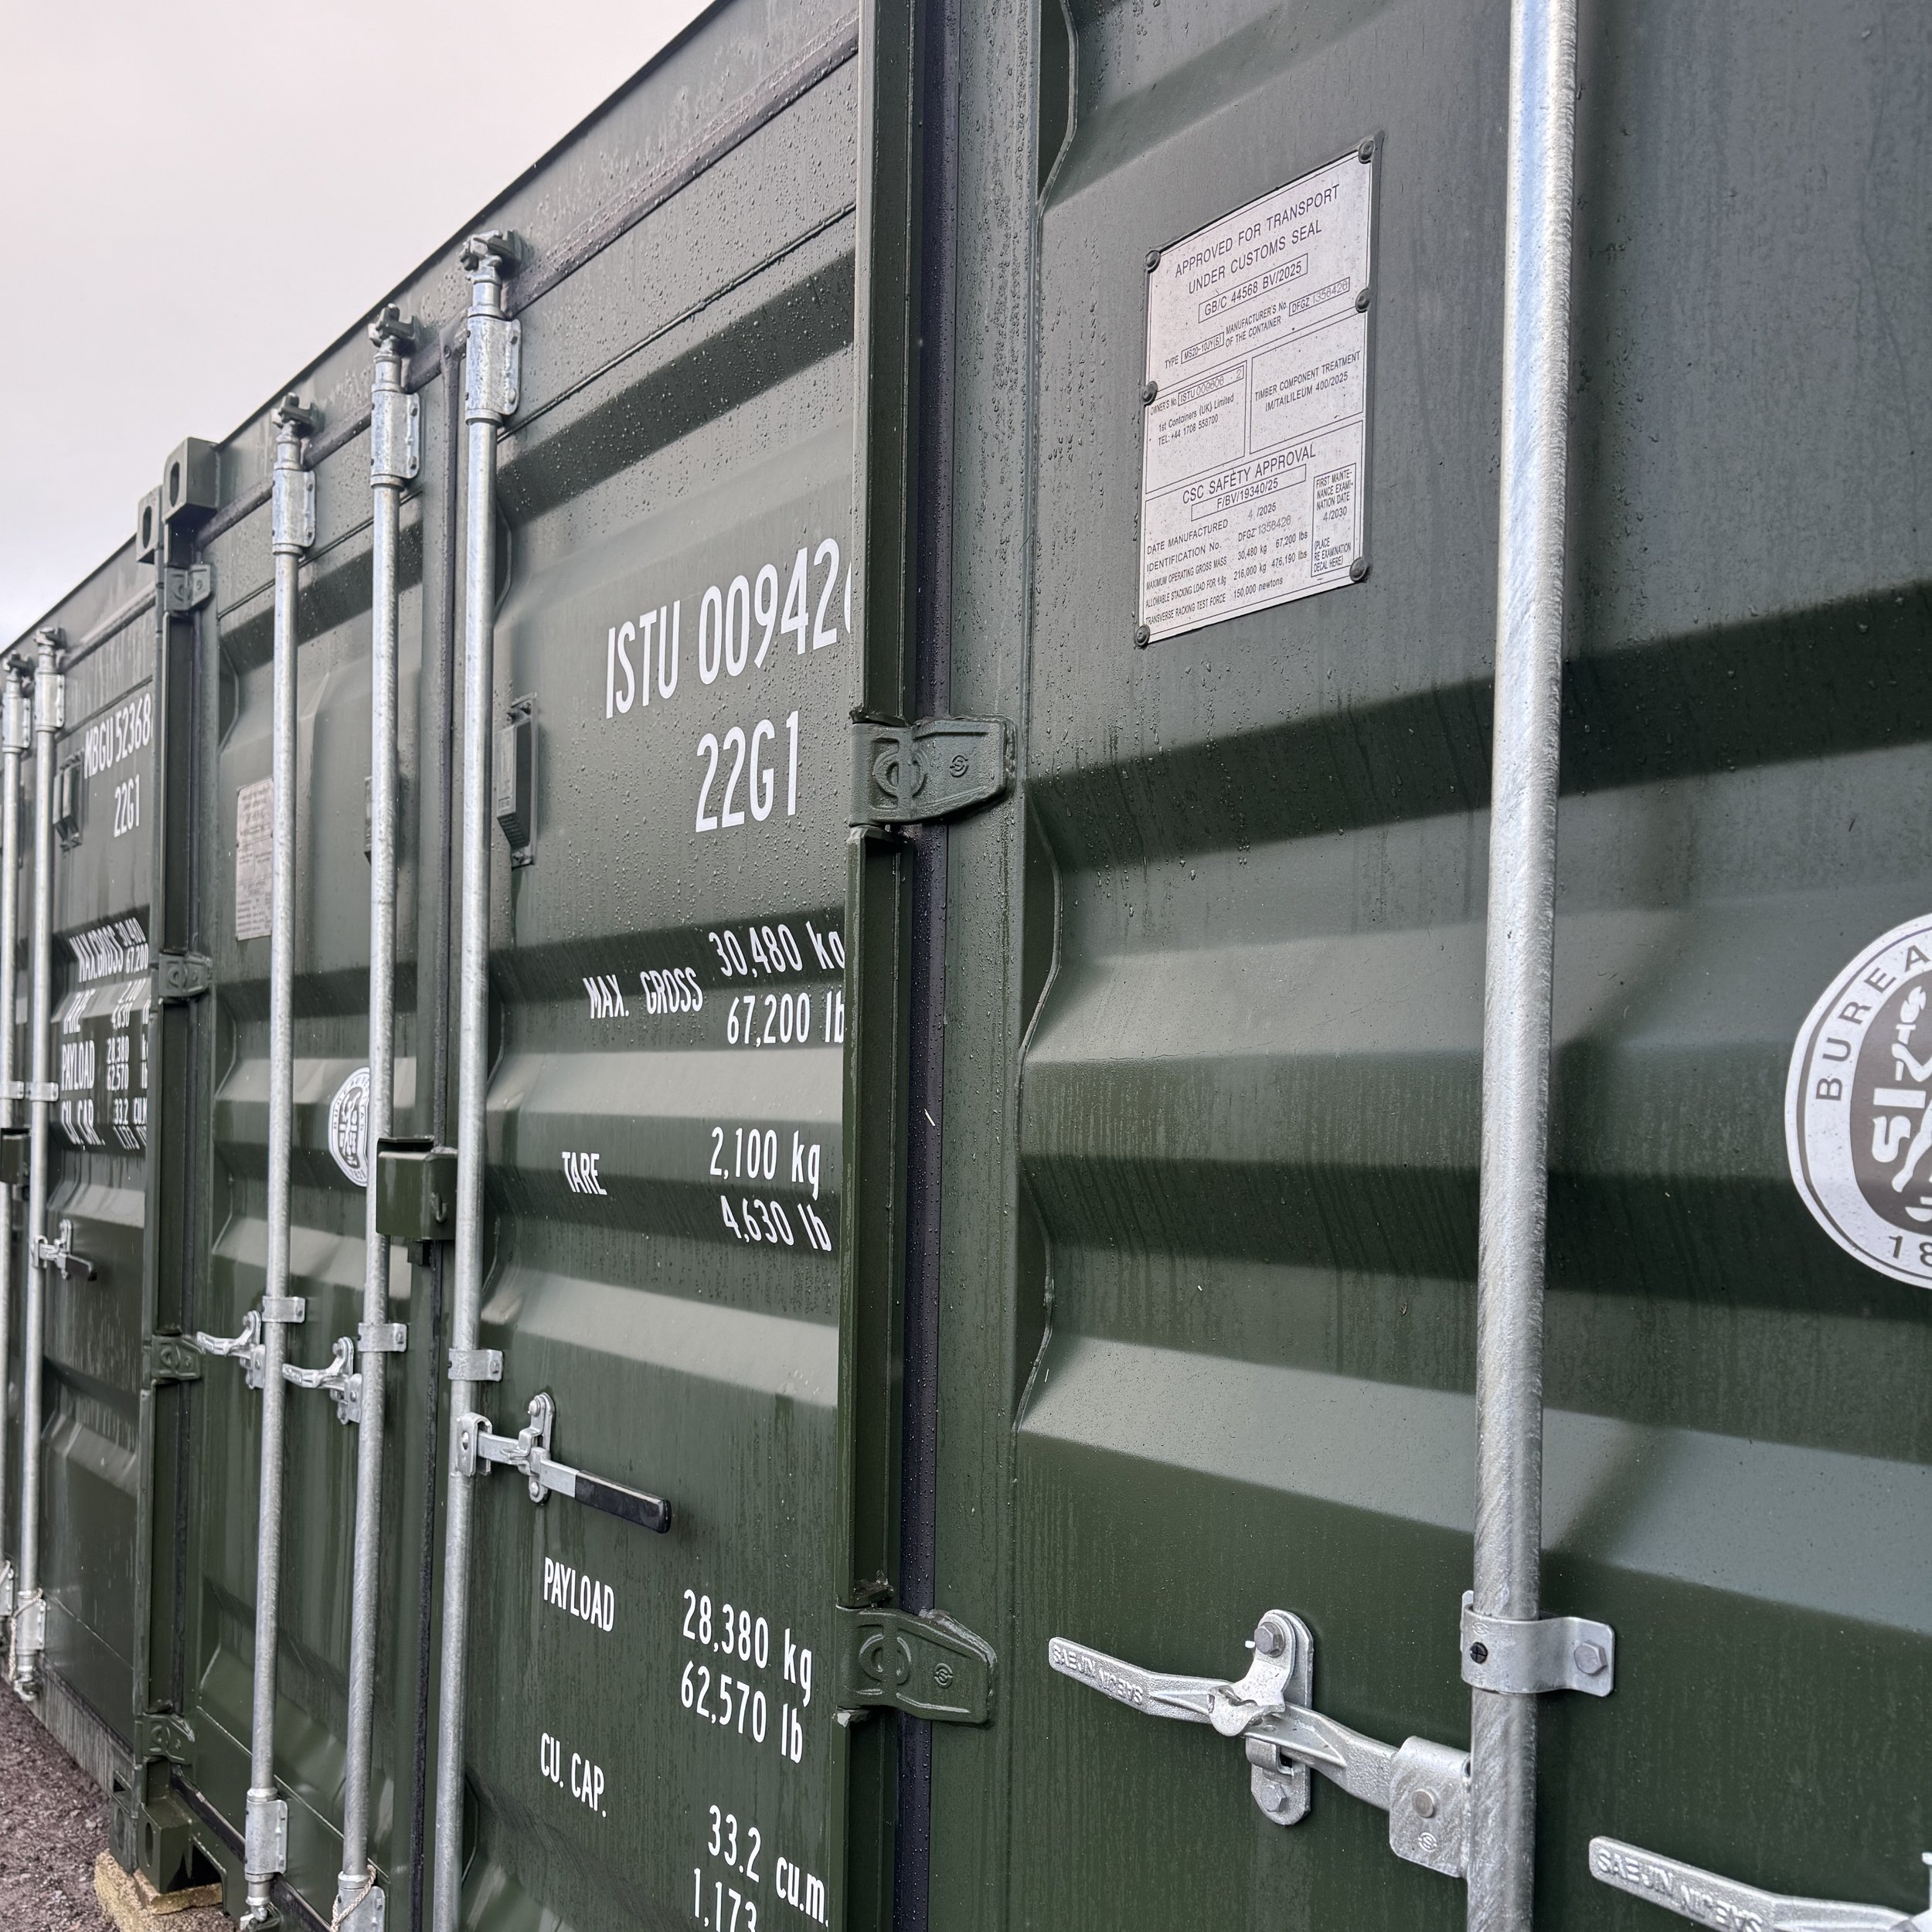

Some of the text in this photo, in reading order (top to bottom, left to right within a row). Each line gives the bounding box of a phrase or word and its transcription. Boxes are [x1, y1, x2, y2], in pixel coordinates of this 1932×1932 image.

[1175, 183, 1340, 278] APPROVED FOR TRANSPORT
[1189, 219, 1322, 294] UNDER CUSTOMS SEAL
[1204, 260, 1301, 316] GB/C 44568 BV/2025
[1225, 315, 1281, 348] OF THE CONTAINER
[1226, 304, 1276, 335] MANUFACTURER'S
[1291, 297, 1310, 313] DFGZ
[1164, 355, 1179, 369] TYPE
[1255, 350, 1361, 401] TIMBER COMPONENT TREATMENT
[1315, 371, 1349, 392] 400/2025
[1150, 399, 1169, 416] OWNER'S
[1180, 389, 1196, 403] ISTU
[1158, 393, 1234, 432] 1st Containers (UK) Limited
[1183, 423, 1196, 436] 1708
[1182, 442, 1316, 504] CSC SAFETY APPROVAL
[1216, 478, 1278, 509] F/BV/19340/25
[1315, 475, 1331, 489] FIRST
[1316, 486, 1334, 500] NANCE
[1316, 491, 1350, 511] NATION DATE
[1146, 531, 1308, 590] MAXIMUM OPERATING GROSS MASS 30,480 kg 67,200 lbs
[1147, 541, 1165, 555] DATE
[1168, 519, 1228, 548] MANUFACTURED
[1147, 545, 1206, 573] IDENTIFICATION
[1209, 542, 1222, 553] No.
[1237, 528, 1256, 542] DFGZ
[1314, 542, 1352, 562] RE EXAMINATION
[1145, 593, 1170, 608] ALLOWABLE
[1171, 586, 1192, 601] STACKING
[1193, 581, 1206, 594] LOAD
[1206, 578, 1216, 590] FOR
[1233, 565, 1257, 580] 216,000
[1259, 563, 1267, 573] kg
[1271, 553, 1296, 569] 476,190
[1298, 550, 1308, 560] lbs
[1314, 555, 1344, 573] DECAL HERE)
[1145, 577, 1283, 625] TRANSVERSE RACKING TEST FORCE 150,000 newtons
[606, 600, 681, 719] ISTU
[83, 692, 153, 780] MBGU 52368
[696, 710, 799, 833] 22G1
[114, 774, 140, 838] 22G1
[583, 974, 629, 1019] MAX.
[639, 967, 703, 1015] GROSS
[709, 923, 803, 978] 30,480
[726, 990, 845, 1047] 67,200 lb
[61, 1039, 95, 1091] PAYLOAD
[562, 1127, 820, 1200] TARE 2,100 kg
[720, 1195, 832, 1252] 4,630 lb
[543, 1556, 812, 1708] PAYLOAD 28,380 kg
[681, 1660, 803, 1764] 62,570 lb
[540, 1733, 564, 1788] CU.
[570, 1752, 607, 1818] CAP.
[708, 1804, 761, 1883] 33.2
